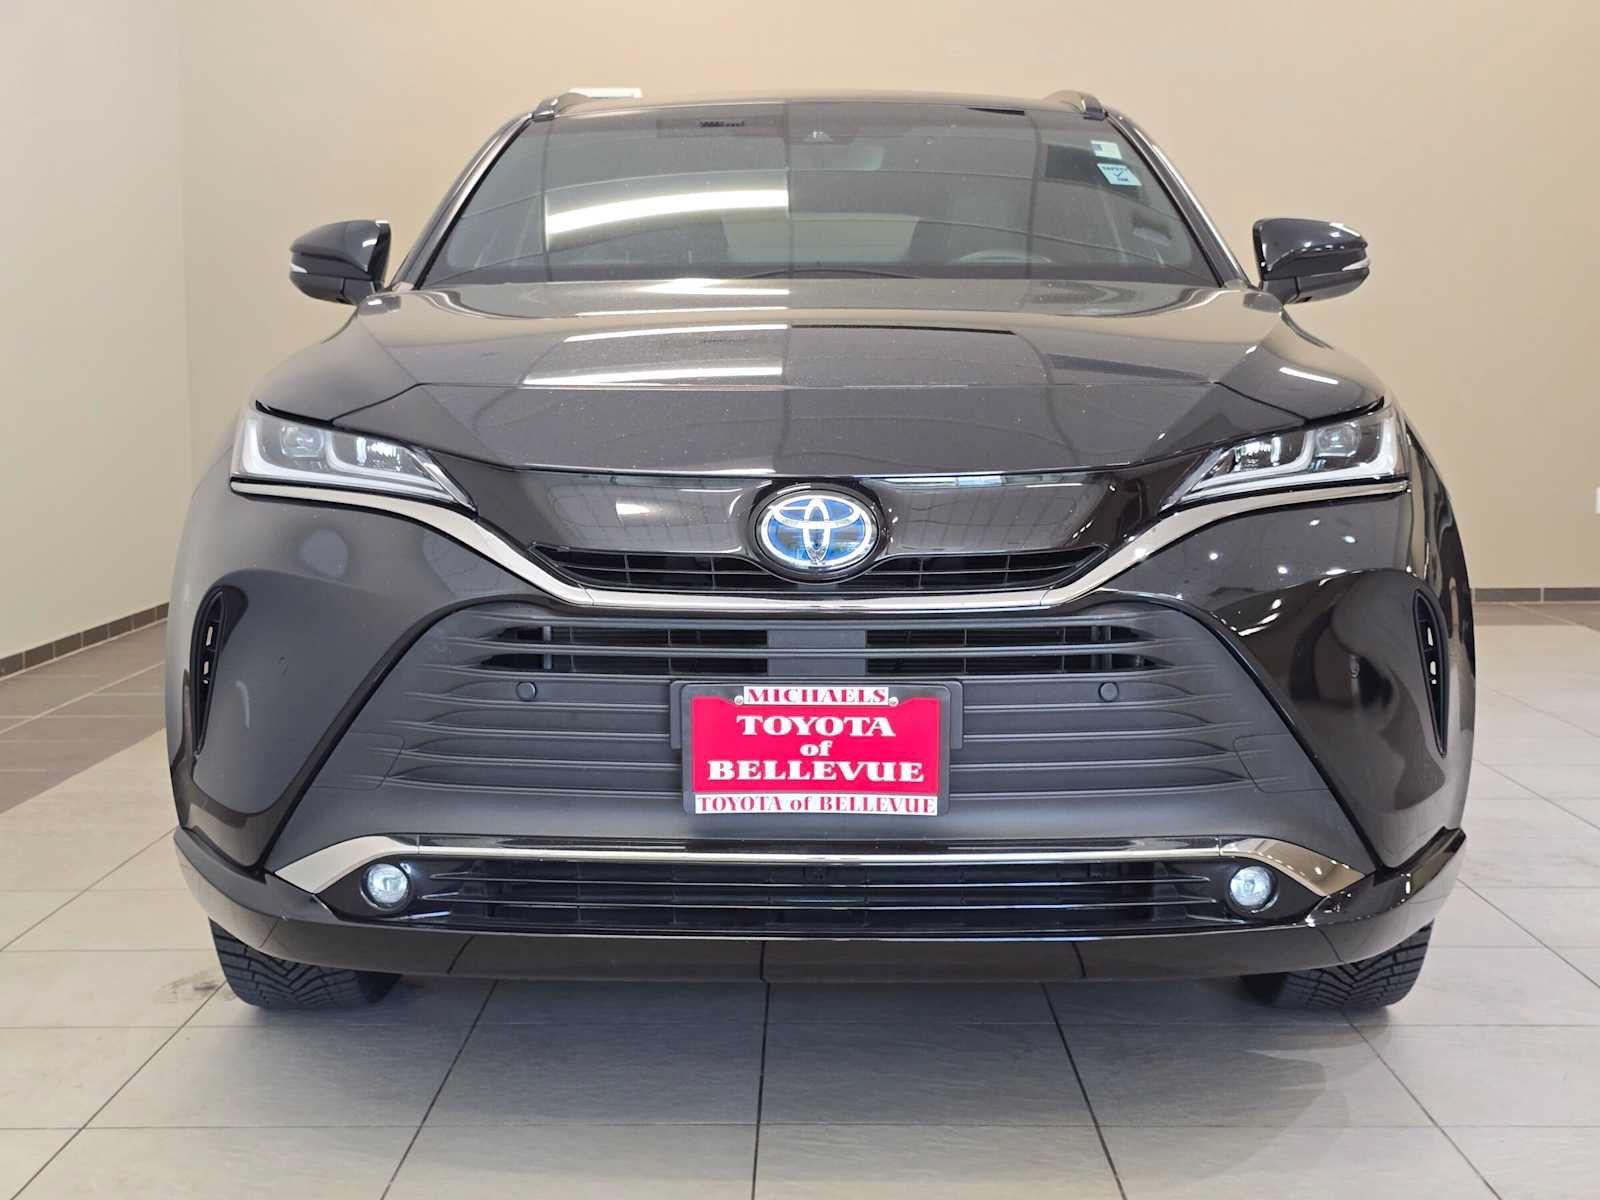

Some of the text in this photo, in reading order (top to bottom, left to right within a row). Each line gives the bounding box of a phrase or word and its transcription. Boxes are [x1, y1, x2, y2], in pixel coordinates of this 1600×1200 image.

[747, 688, 886, 703] MICHAELS
[736, 715, 896, 737] TOYOTA
[800, 740, 833, 757] of
[707, 760, 925, 783] BELLEVUE
[697, 795, 936, 814] TOYOTA of BELLEVUE
